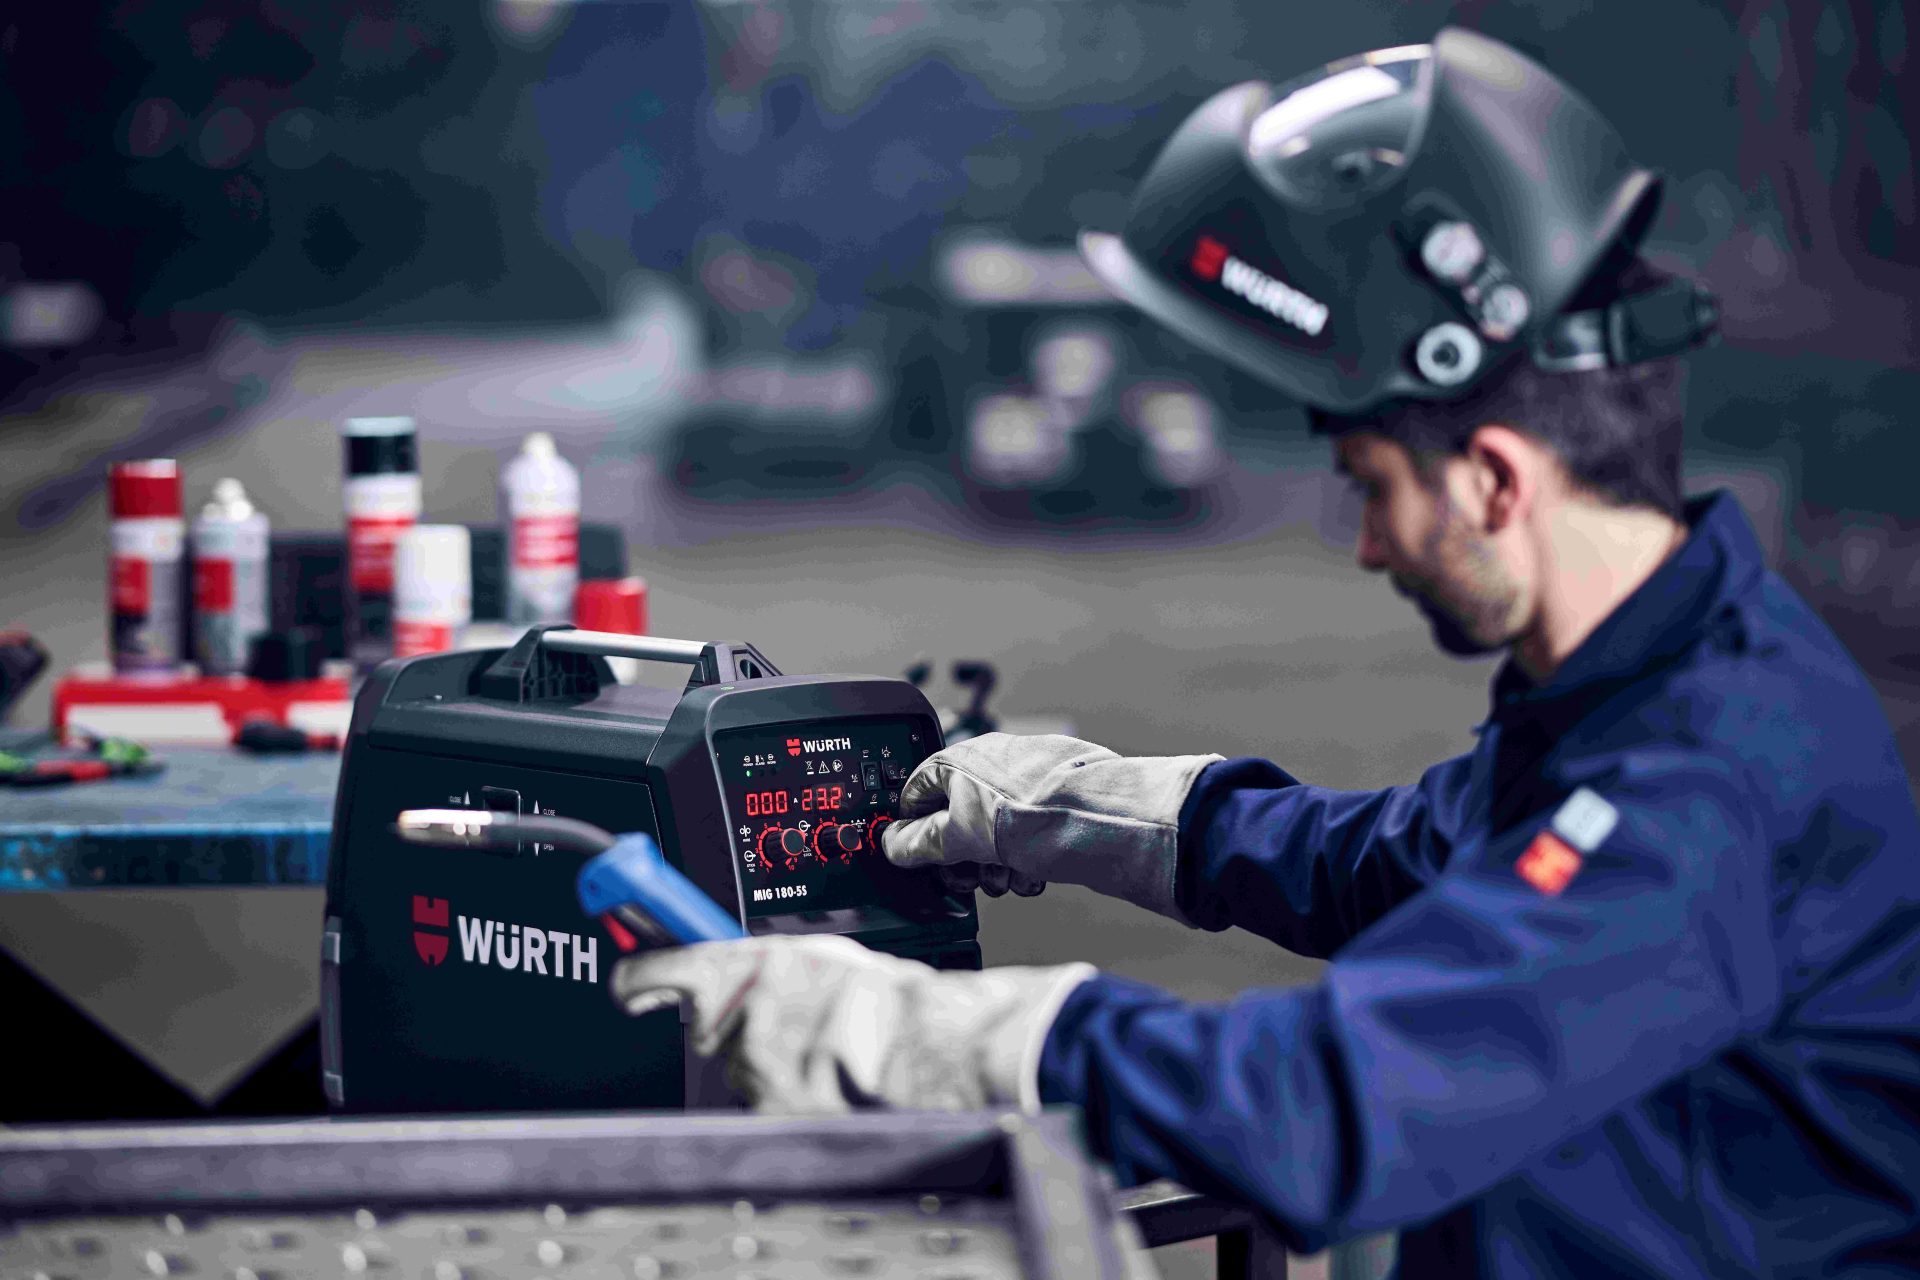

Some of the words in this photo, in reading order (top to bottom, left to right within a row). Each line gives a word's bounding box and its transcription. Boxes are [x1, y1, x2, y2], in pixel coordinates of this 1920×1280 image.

[802, 737, 852, 753] WÜRTH
[746, 791, 788, 816] 000
[542, 808, 556, 817] CLOSE
[753, 888, 773, 901] MIG
[774, 884, 808, 899] 180-5S
[458, 915, 598, 983] WÜRTH
